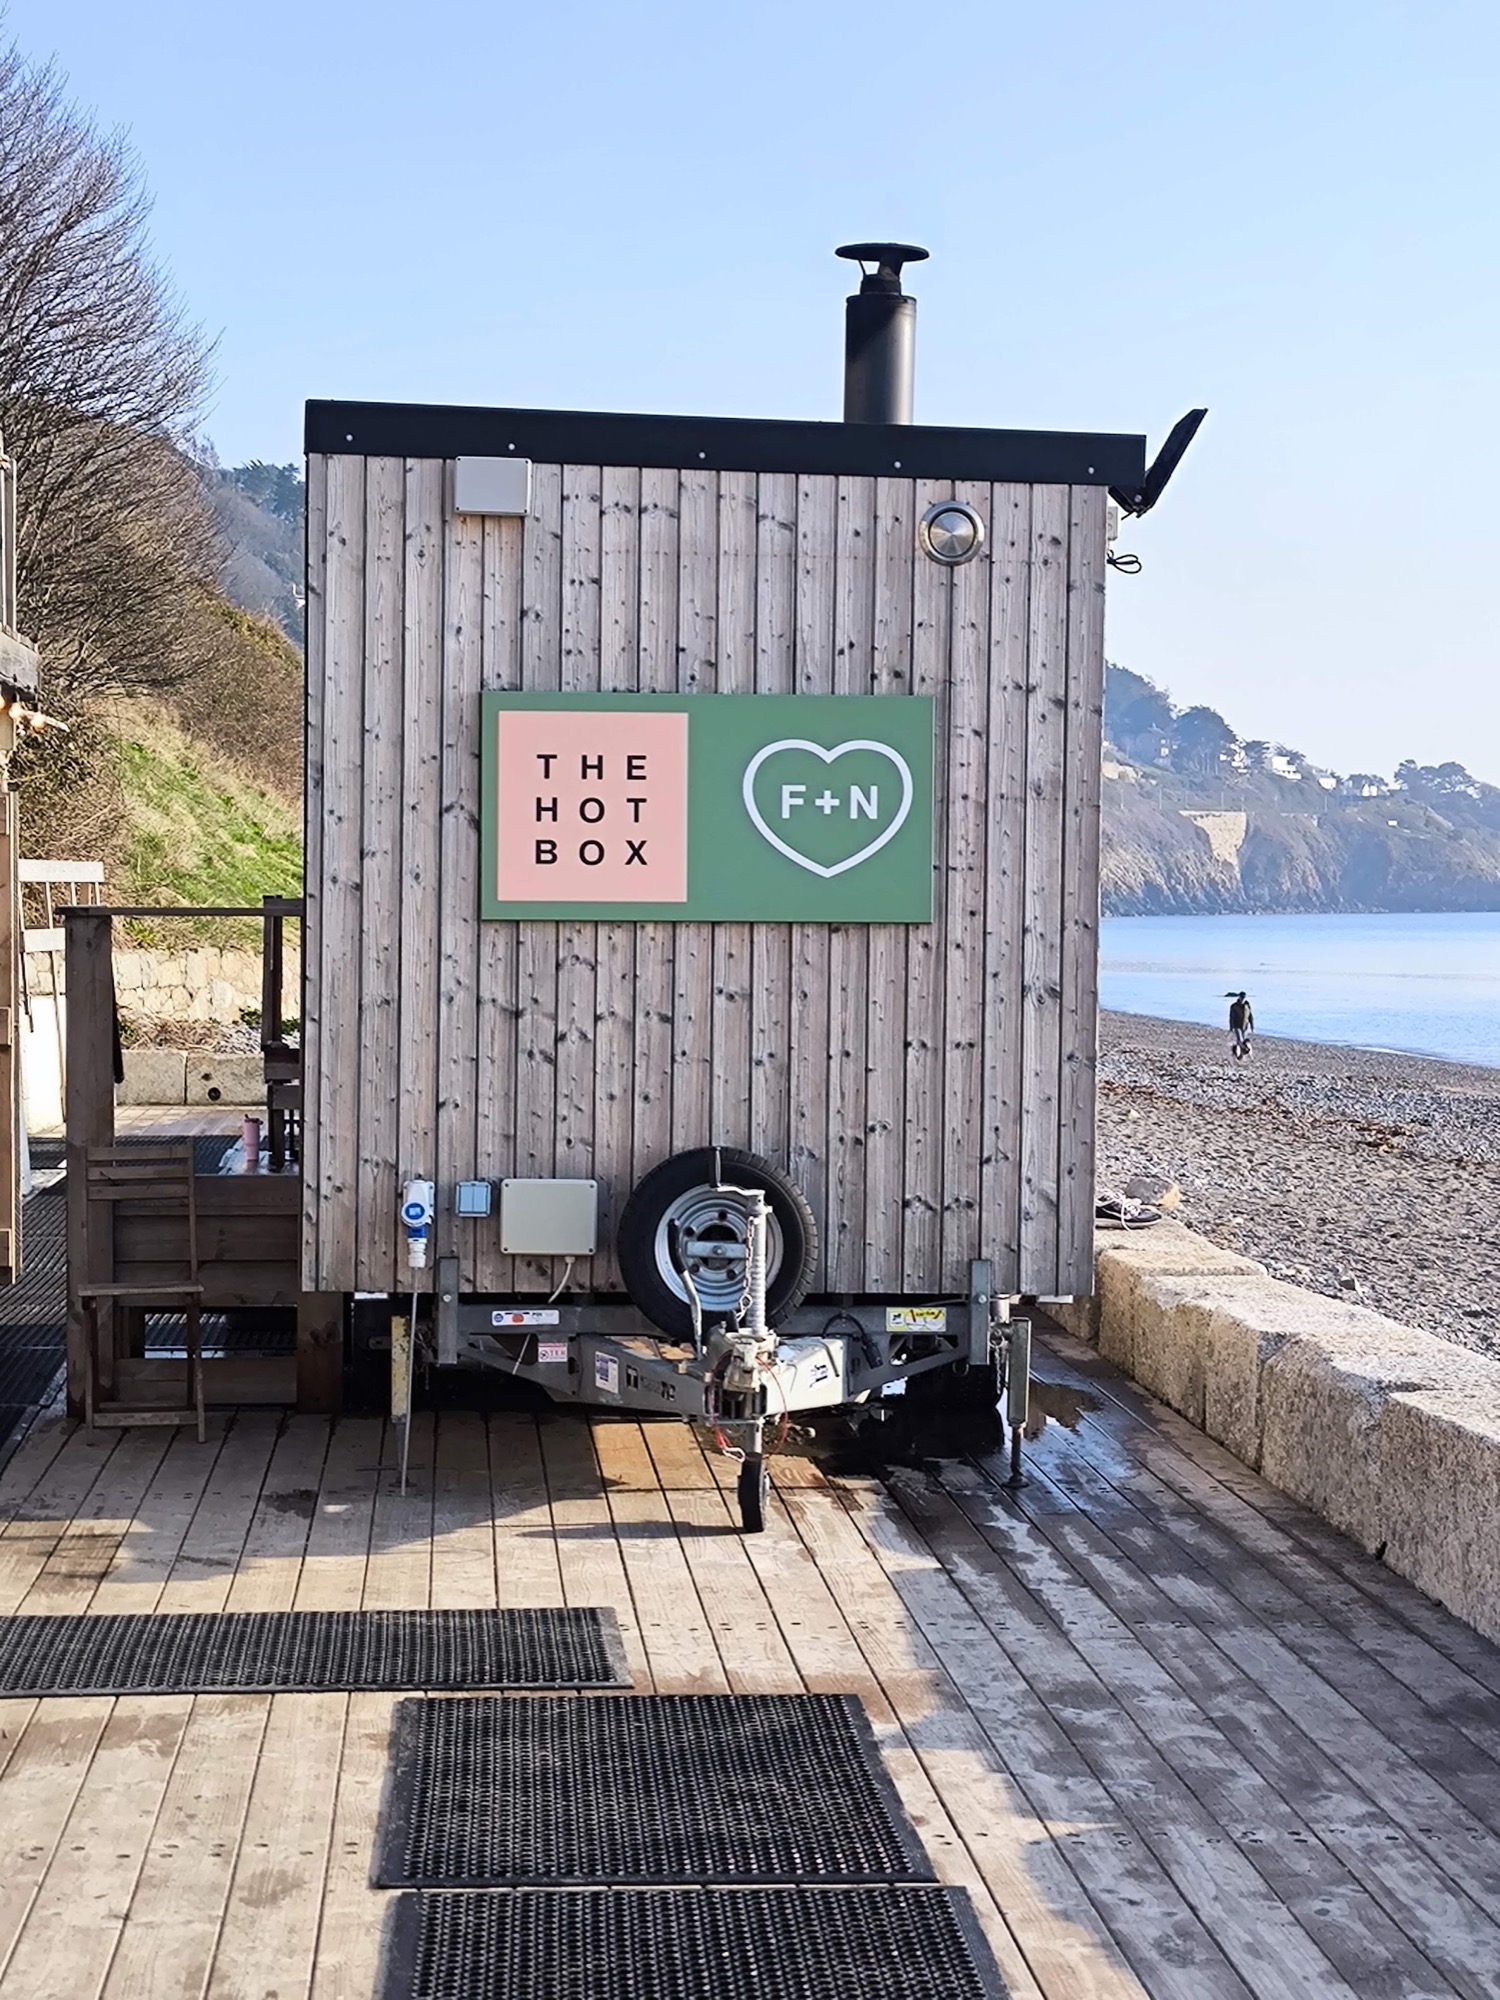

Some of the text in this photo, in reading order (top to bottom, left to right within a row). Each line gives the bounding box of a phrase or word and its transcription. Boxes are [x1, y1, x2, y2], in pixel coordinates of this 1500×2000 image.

[536, 753, 647, 781] THE
[535, 796, 648, 824] HOT
[781, 784, 879, 820] F+N
[535, 839, 648, 866] BOX
